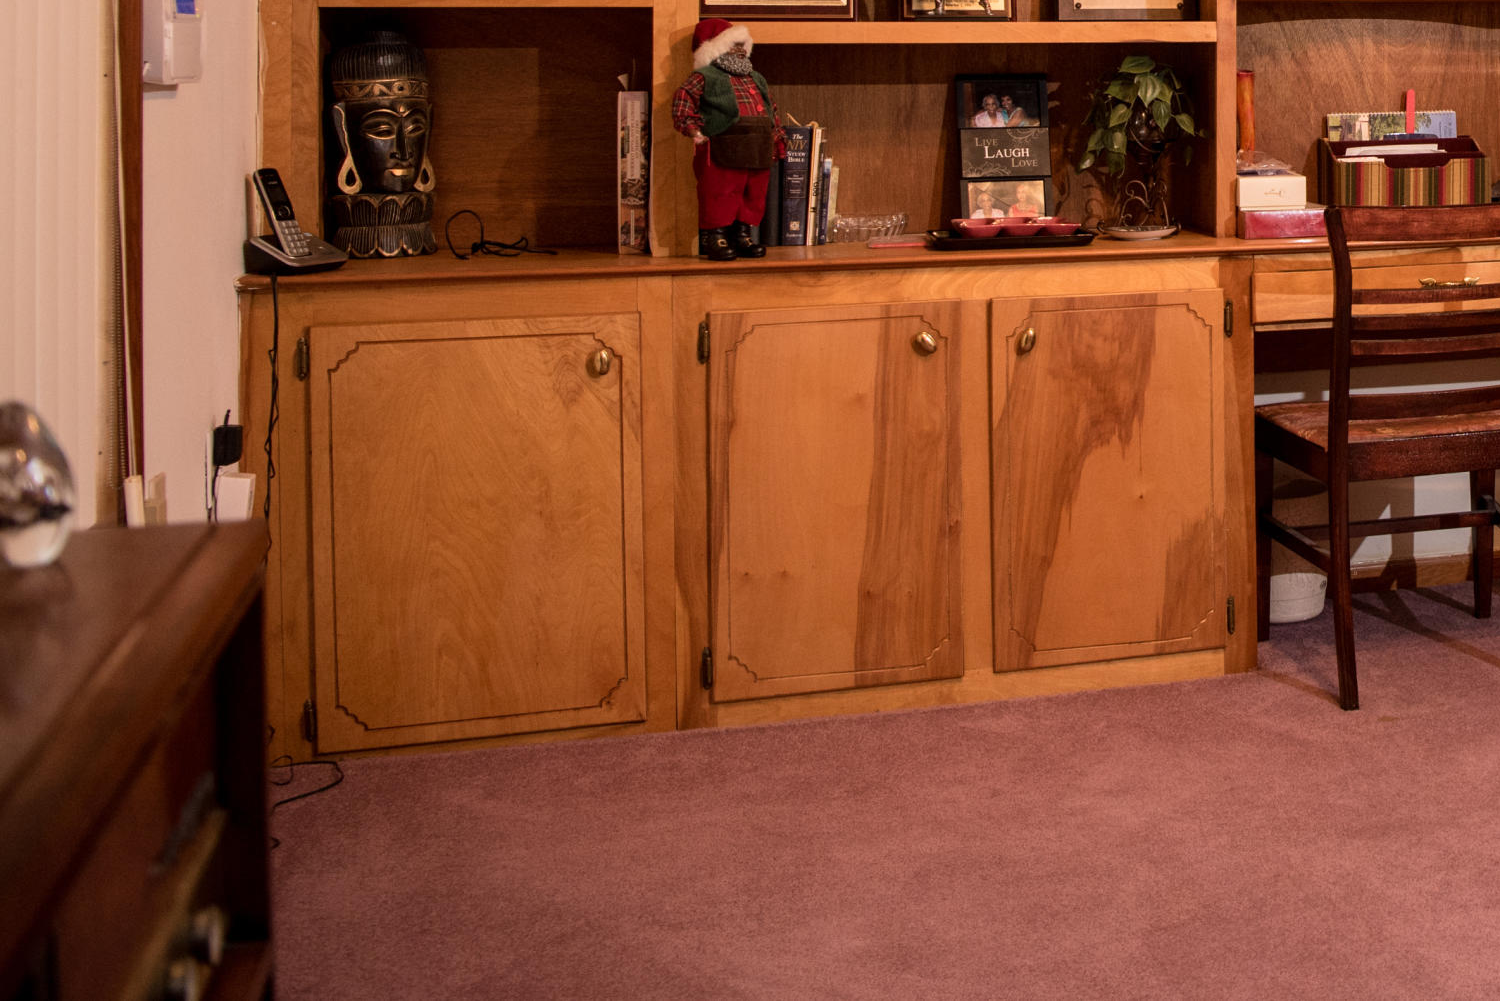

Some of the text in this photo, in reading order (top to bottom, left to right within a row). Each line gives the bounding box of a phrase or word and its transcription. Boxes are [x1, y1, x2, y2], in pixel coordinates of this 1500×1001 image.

[787, 140, 807, 150] NIV
[975, 137, 998, 147] LIVE
[984, 146, 1029, 159] LAUGH
[1011, 158, 1038, 167] LOVE
